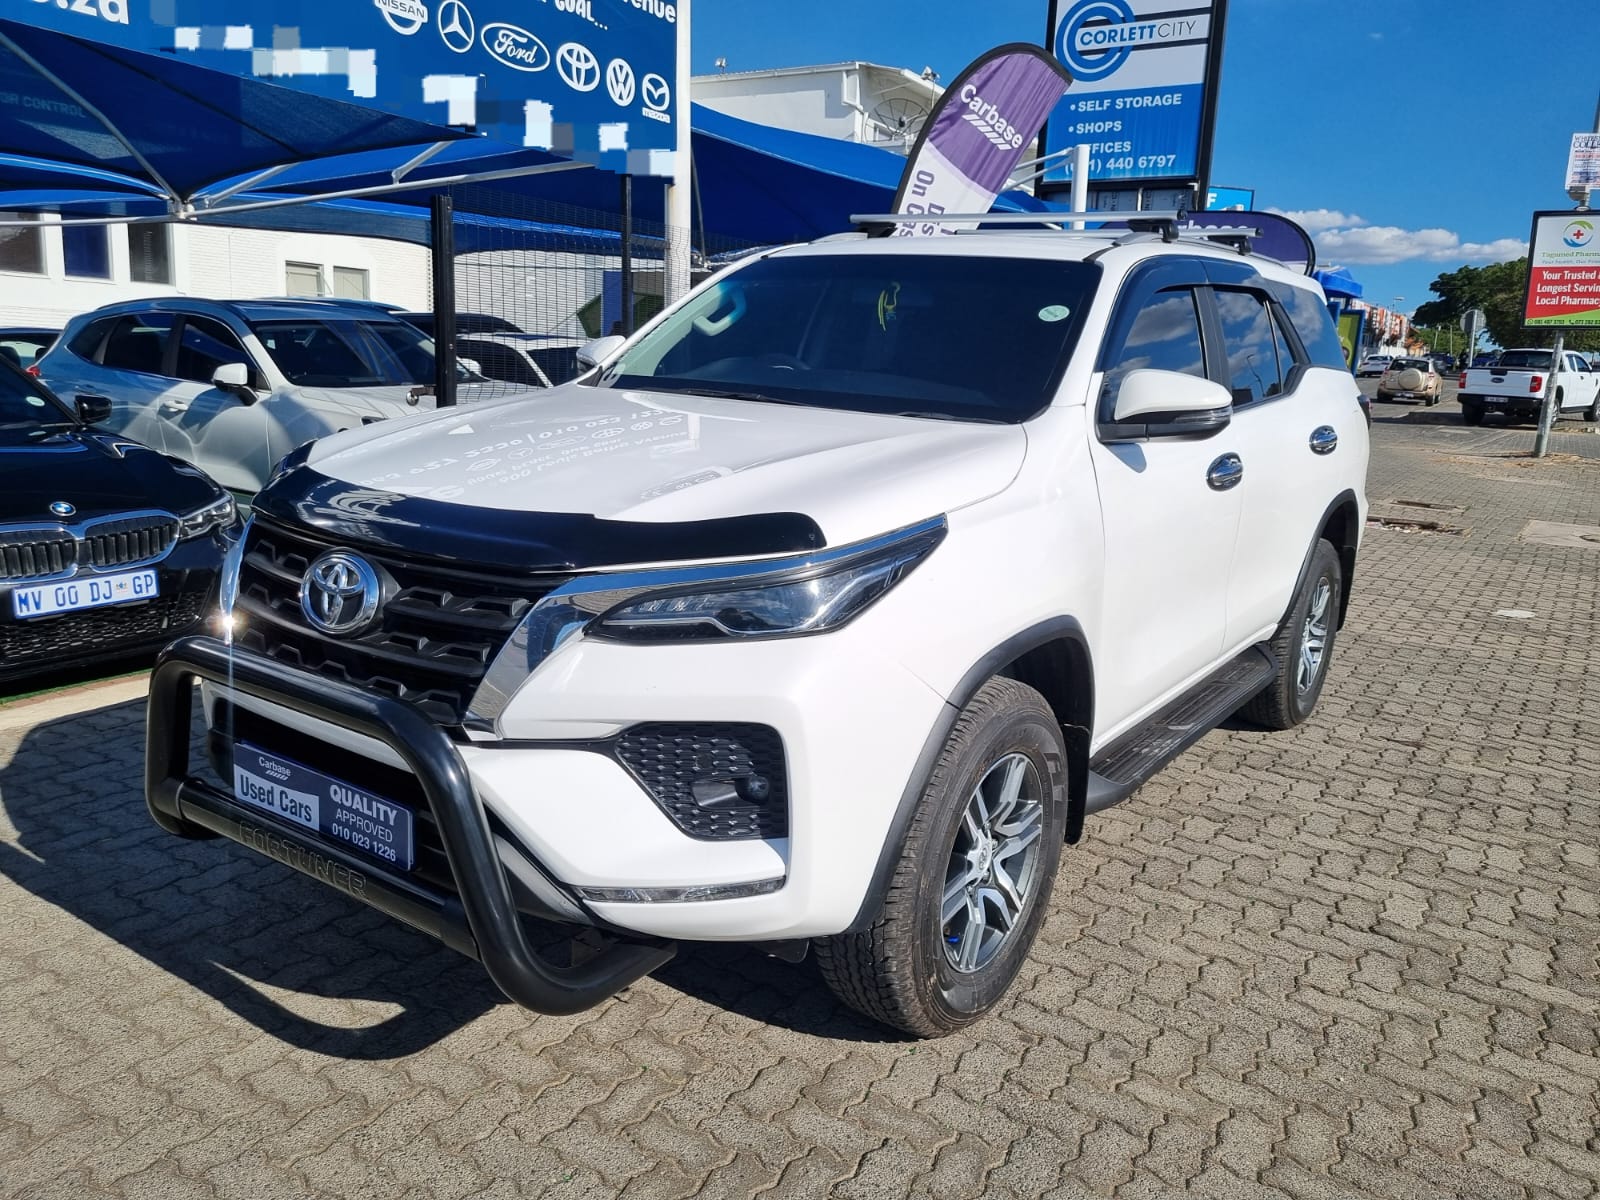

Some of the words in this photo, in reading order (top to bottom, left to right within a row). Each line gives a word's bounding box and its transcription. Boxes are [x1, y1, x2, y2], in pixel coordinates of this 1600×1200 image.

[378, 0, 425, 18] NISSAN
[494, 29, 538, 64] Ford
[1078, 99, 1111, 112] SELF
[1115, 93, 1182, 110] STORAGE
[961, 84, 1023, 148] Carbase
[1076, 121, 1122, 134] SHOPS
[1084, 141, 1131, 154] FICES
[1106, 157, 1134, 170] 440
[1138, 154, 1176, 168] 6797
[912, 170, 934, 197] On
[1542, 271, 1561, 279] Your
[1563, 270, 1597, 280] Trusted
[1537, 284, 1571, 294] Longest
[1536, 296, 1558, 305] Local
[17, 590, 42, 613] MV
[89, 580, 112, 602] DJ
[132, 574, 154, 596] GP
[258, 756, 291, 777] Carbase
[240, 774, 275, 806] Used
[279, 790, 312, 823] Cars
[330, 784, 398, 826] QUALITY
[335, 808, 393, 843] APPROVED
[332, 822, 350, 841] 010
[352, 829, 370, 849] 023
[373, 839, 396, 862] 1226
